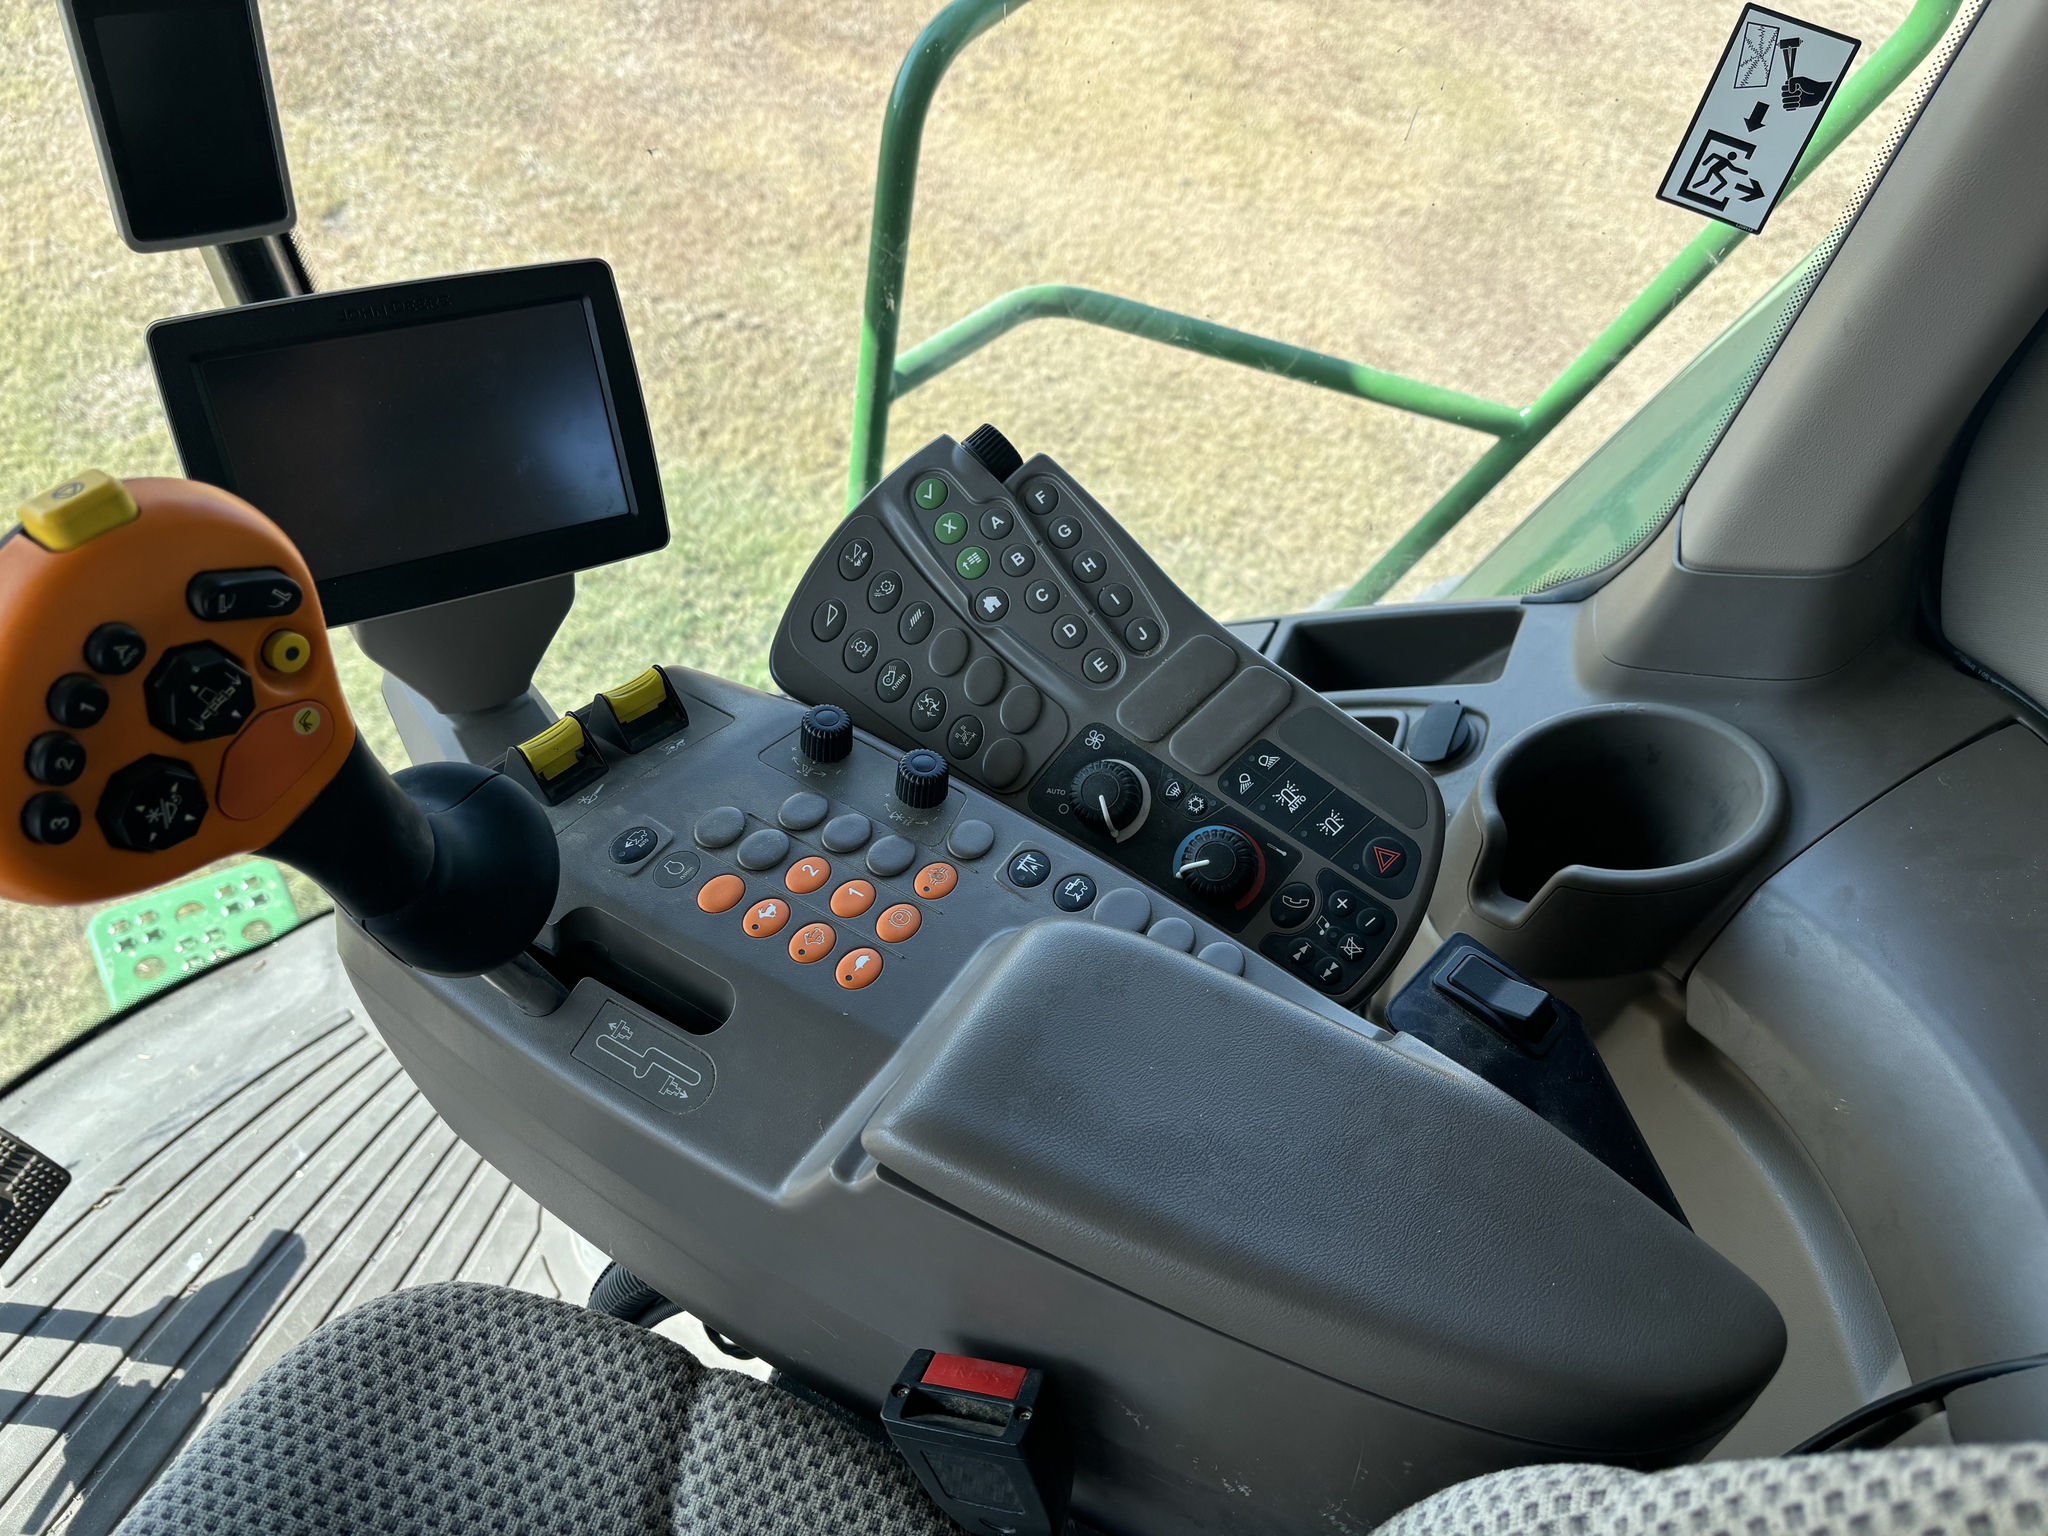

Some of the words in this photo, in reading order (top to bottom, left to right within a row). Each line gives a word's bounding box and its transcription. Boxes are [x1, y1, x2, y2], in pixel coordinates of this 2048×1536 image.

[342, 303, 388, 321] JOHN
[391, 294, 453, 314] DEERE
[1035, 490, 1047, 504] F
[992, 516, 1004, 529] A
[1058, 525, 1071, 537] G
[1011, 553, 1024, 566] B
[1082, 558, 1096, 572] H
[1036, 589, 1048, 601] C
[1063, 624, 1076, 638] D
[1137, 627, 1148, 641] J
[1093, 658, 1108, 672] E
[891, 673, 907, 691] n/min
[80, 702, 96, 713] 1
[55, 757, 74, 770] 2
[1046, 787, 1066, 797] AUTO
[1288, 794, 1307, 814] AUTO
[50, 817, 69, 829] 3
[802, 865, 819, 876] 2
[848, 887, 865, 898] 1
[894, 913, 905, 923] P
[941, 1363, 1000, 1385] PRESS
